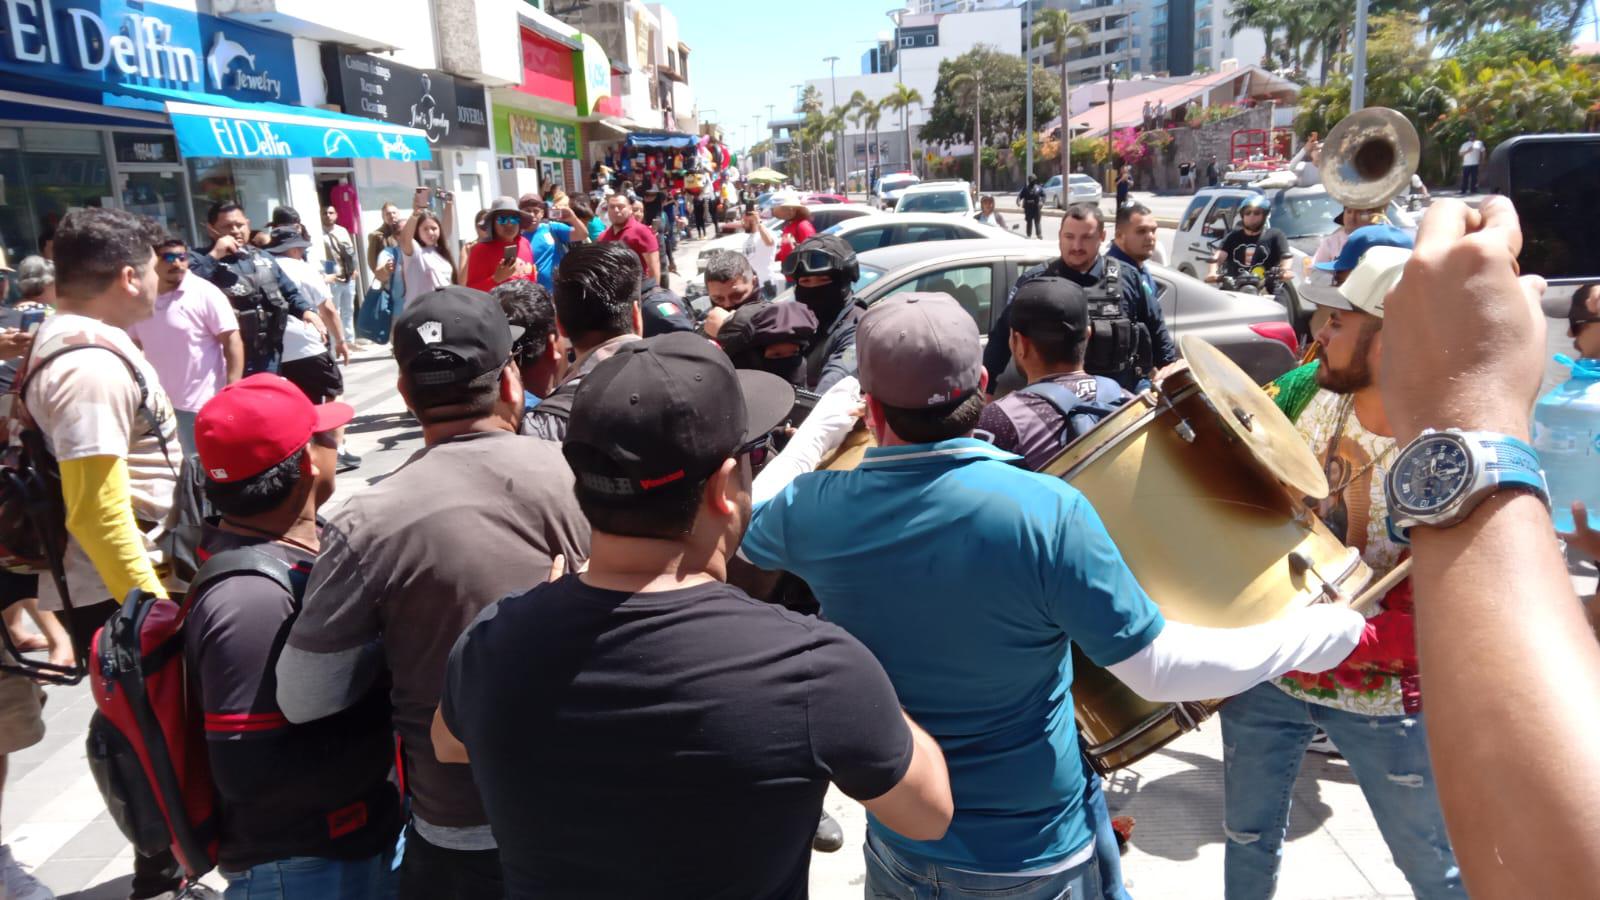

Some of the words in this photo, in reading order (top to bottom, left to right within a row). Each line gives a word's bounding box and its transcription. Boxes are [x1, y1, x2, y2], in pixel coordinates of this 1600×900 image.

[7, 0, 61, 64] El
[236, 69, 281, 98] Jewelry
[457, 106, 485, 126] JOYERIA
[208, 117, 238, 155] El
